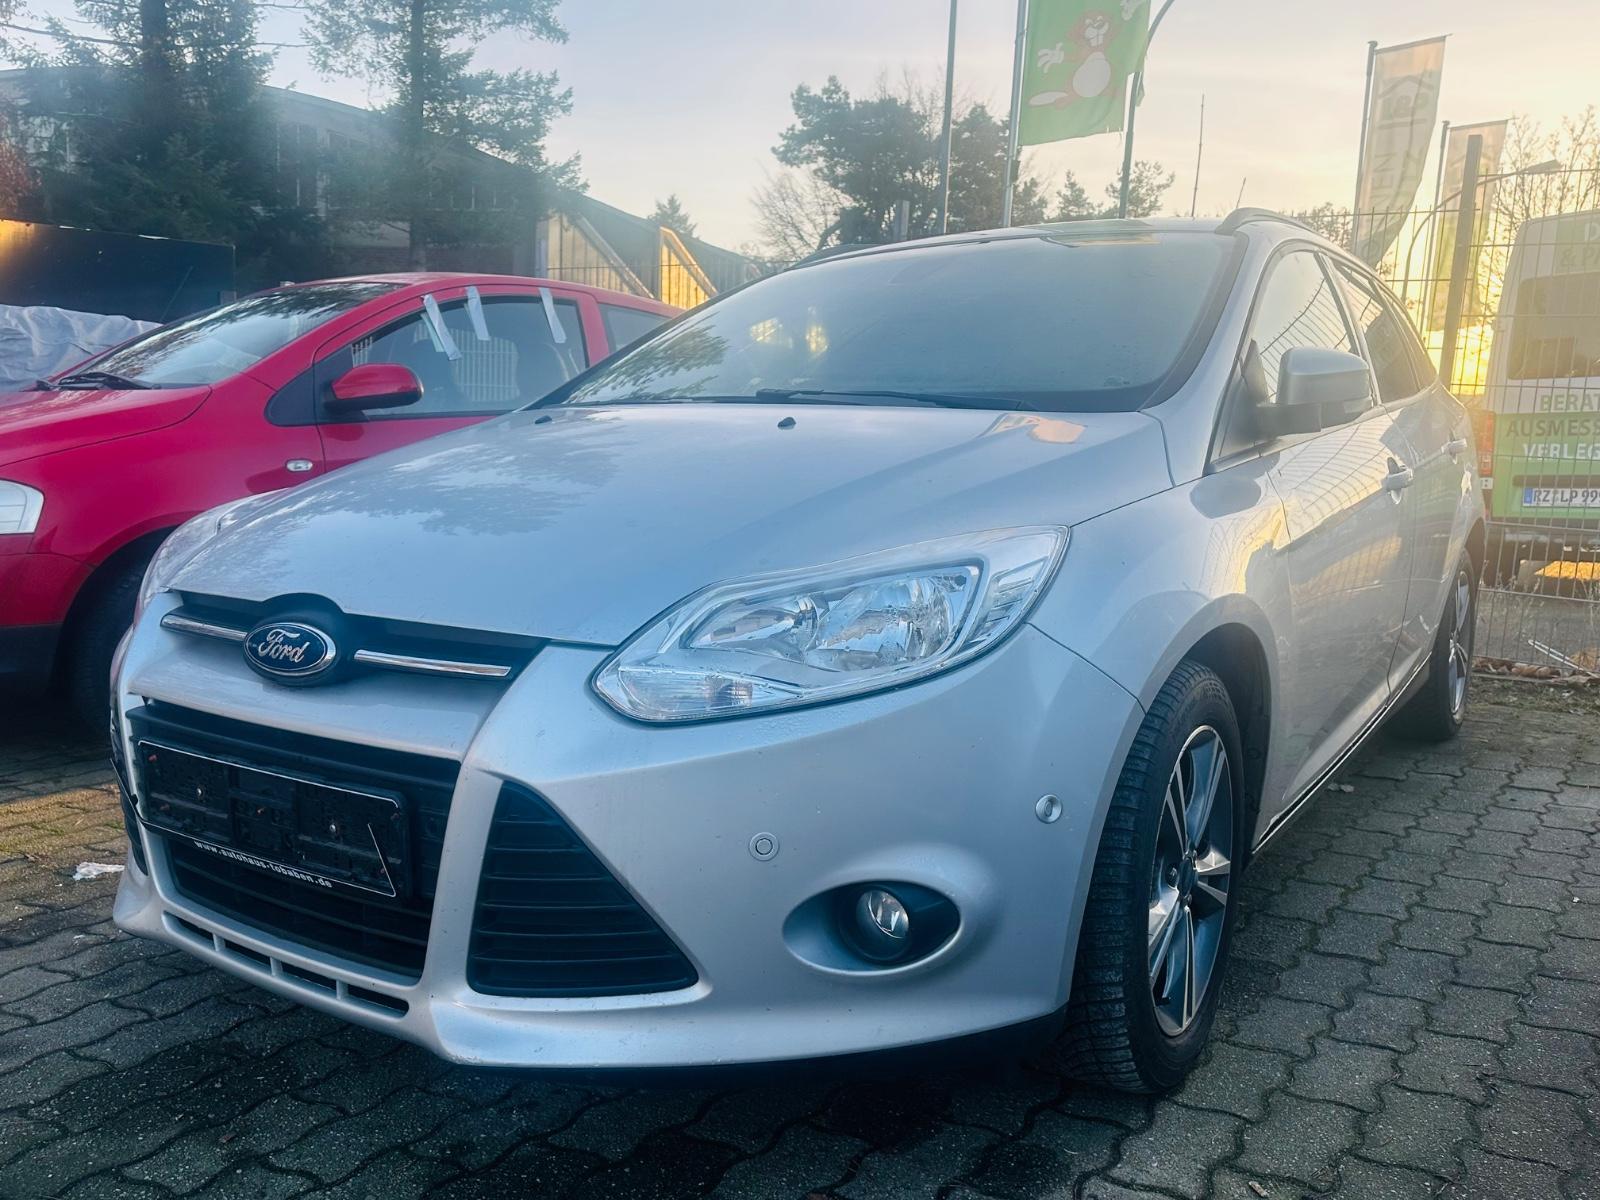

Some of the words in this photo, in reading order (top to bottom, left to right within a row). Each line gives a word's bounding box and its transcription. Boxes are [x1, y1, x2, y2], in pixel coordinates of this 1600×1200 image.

[1541, 393, 1600, 412] BERAT
[1522, 442, 1600, 461] VERLEG
[1533, 489, 1551, 503] RZ
[1560, 490, 1578, 503] LP
[258, 629, 310, 662] Ford
[193, 840, 333, 888] www.autohaus-tobaben.de
